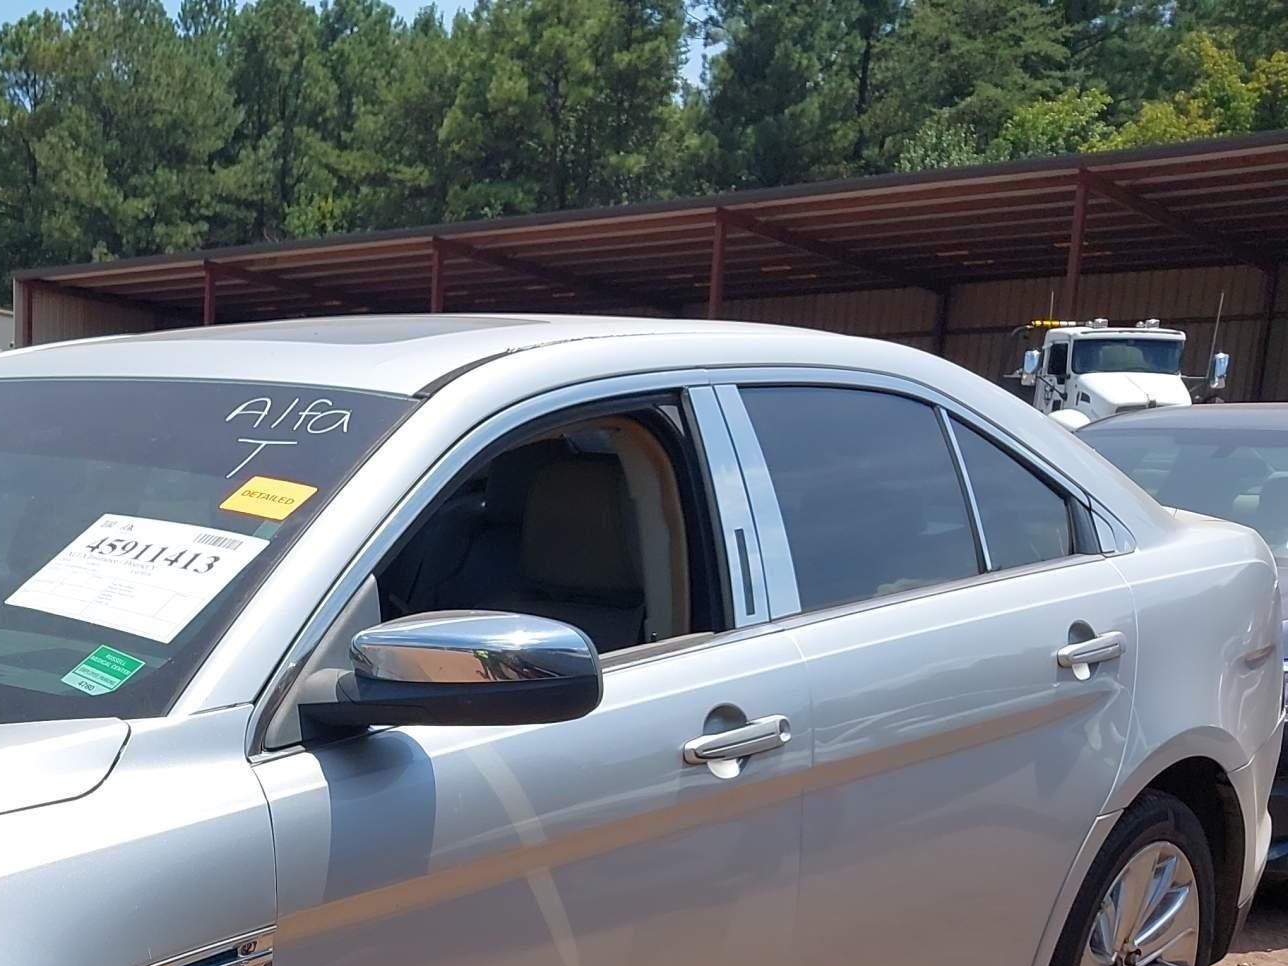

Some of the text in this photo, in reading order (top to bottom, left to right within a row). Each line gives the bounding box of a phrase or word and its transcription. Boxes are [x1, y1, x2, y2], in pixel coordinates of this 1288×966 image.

[225, 397, 352, 434] Alfa
[225, 438, 298, 479] T
[240, 488, 296, 506] DETAILED
[85, 536, 221, 574] 45911413
[110, 663, 132, 676] CENTER
